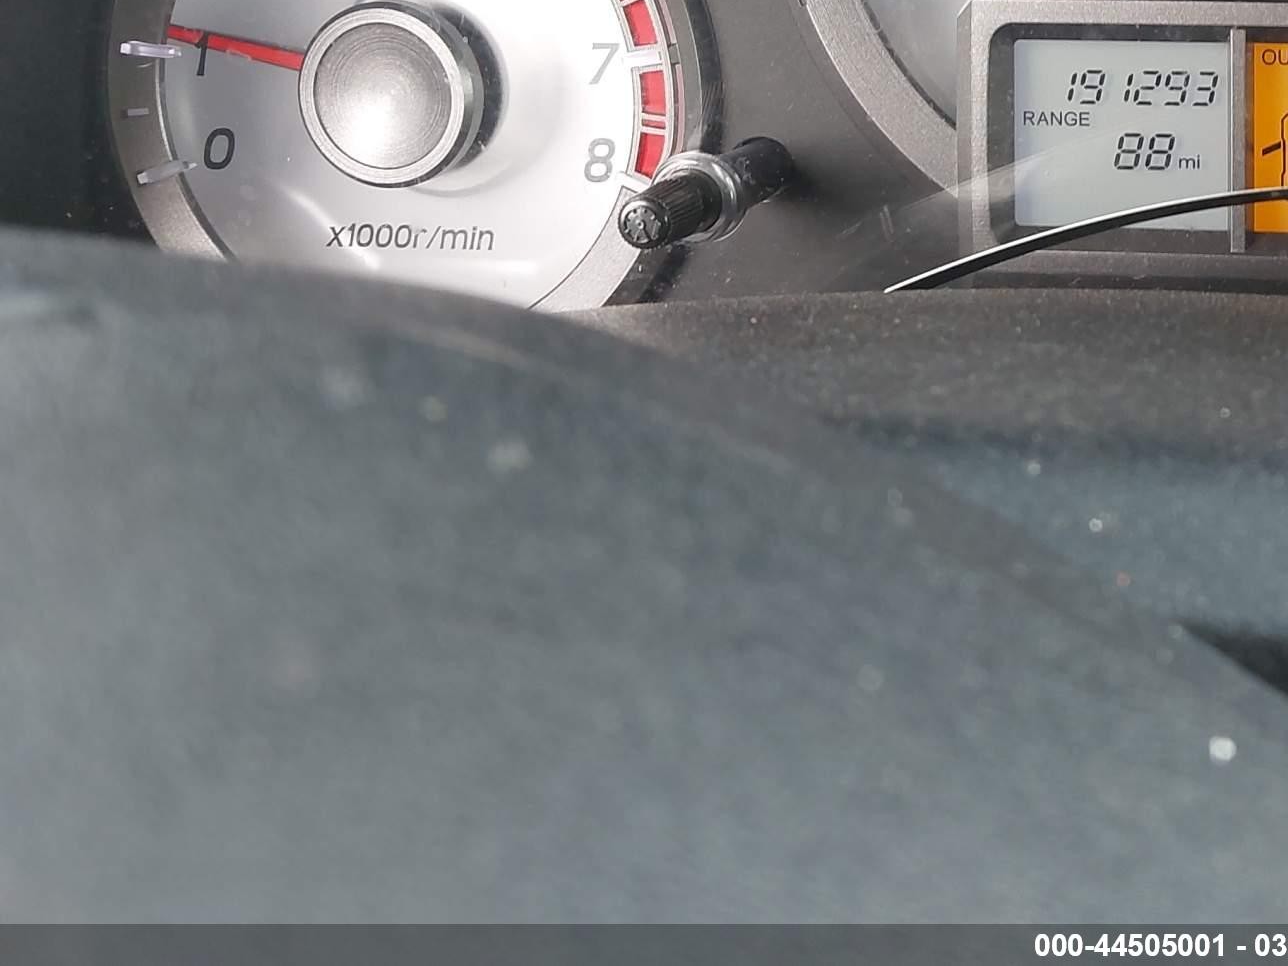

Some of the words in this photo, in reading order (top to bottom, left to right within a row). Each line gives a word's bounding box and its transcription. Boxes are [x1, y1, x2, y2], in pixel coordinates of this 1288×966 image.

[587, 42, 620, 85] 7
[1067, 70, 1218, 106] 191293
[1023, 110, 1091, 127] RANGE
[203, 128, 235, 170] 0
[584, 138, 616, 183] 8
[1178, 154, 1201, 169] mi
